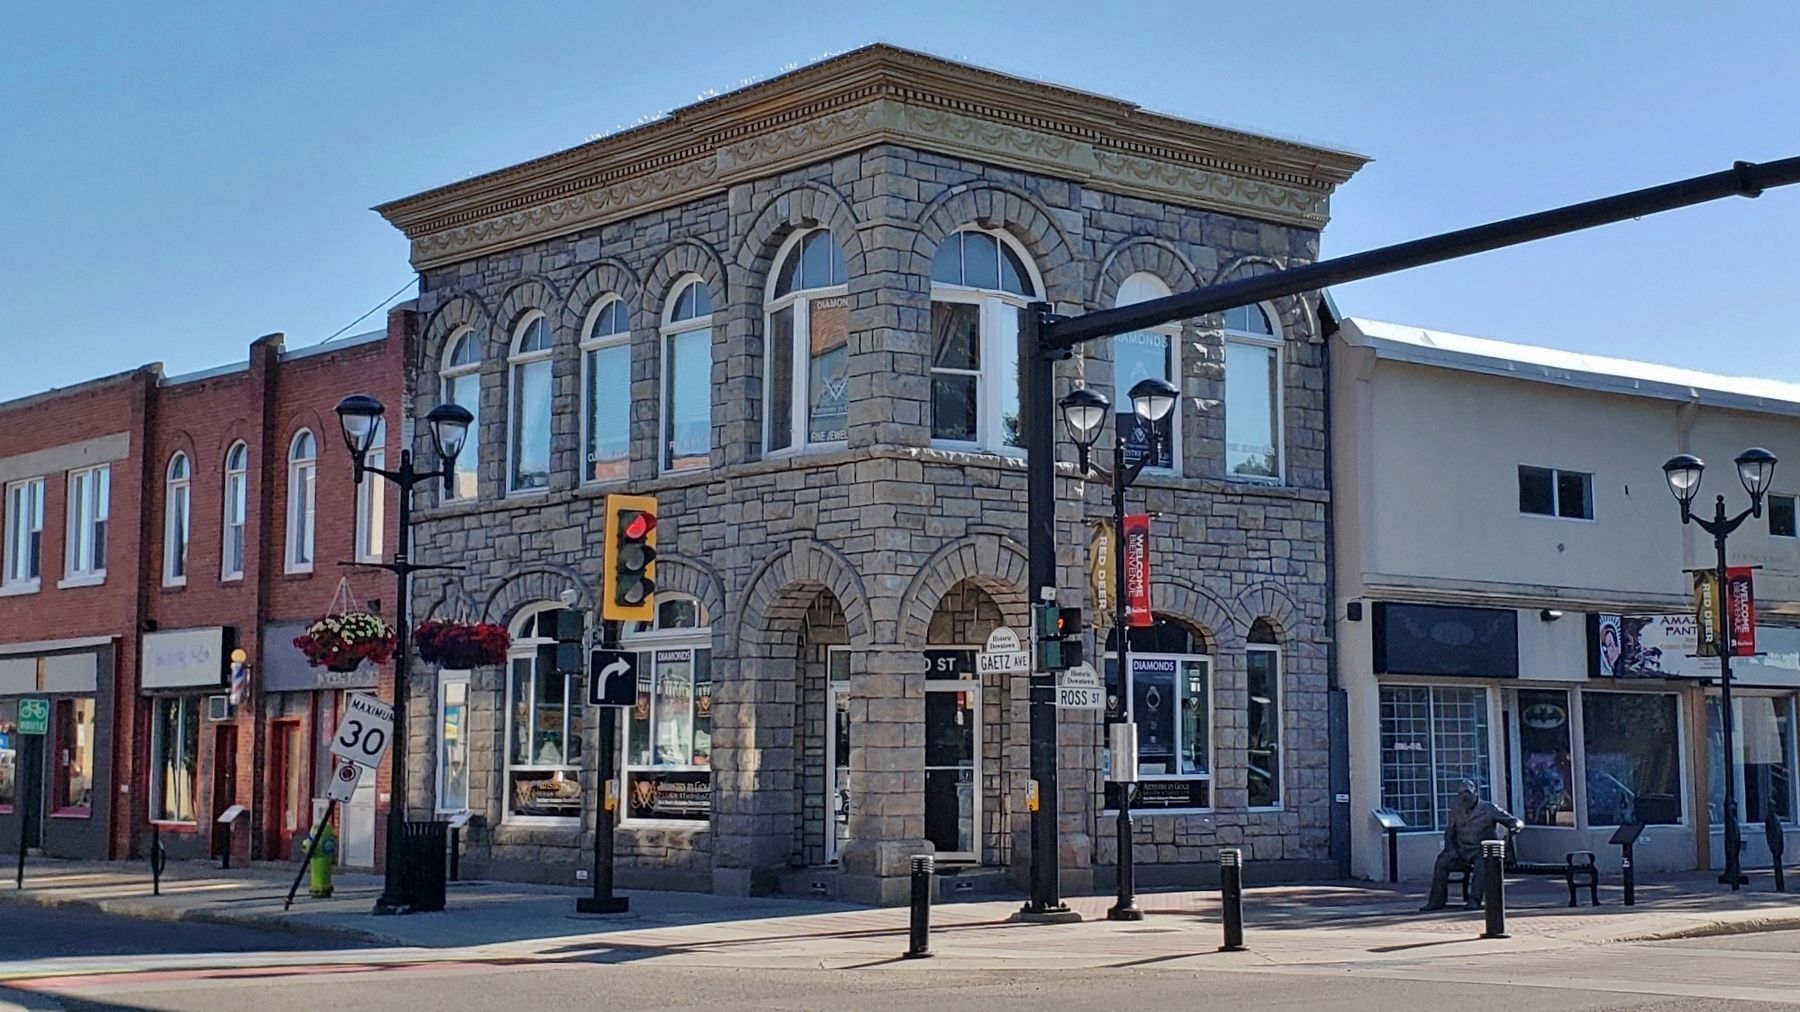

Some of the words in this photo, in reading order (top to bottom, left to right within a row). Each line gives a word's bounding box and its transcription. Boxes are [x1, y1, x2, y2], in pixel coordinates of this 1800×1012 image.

[1098, 536, 1107, 565] RED
[1128, 534, 1137, 597] BIENVENUE
[1136, 533, 1144, 598] WELCOME
[1098, 570, 1107, 609] DEER
[1702, 583, 1711, 608] RED
[1733, 581, 1742, 633] BIENVENUE
[1738, 581, 1750, 633] WELCOME
[1703, 611, 1713, 643] DEER
[657, 650, 690, 662] DIAMONDS
[990, 642, 1015, 650] Downtown
[937, 657, 956, 672] ST
[981, 653, 1011, 671] GAETZ
[1014, 656, 1027, 667] AVE
[1133, 660, 1174, 671] DIAMONDS
[1067, 677, 1095, 685] Downtown
[1061, 690, 1087, 706] ROSS
[1092, 693, 1100, 704] ST
[340, 720, 385, 755] 30
